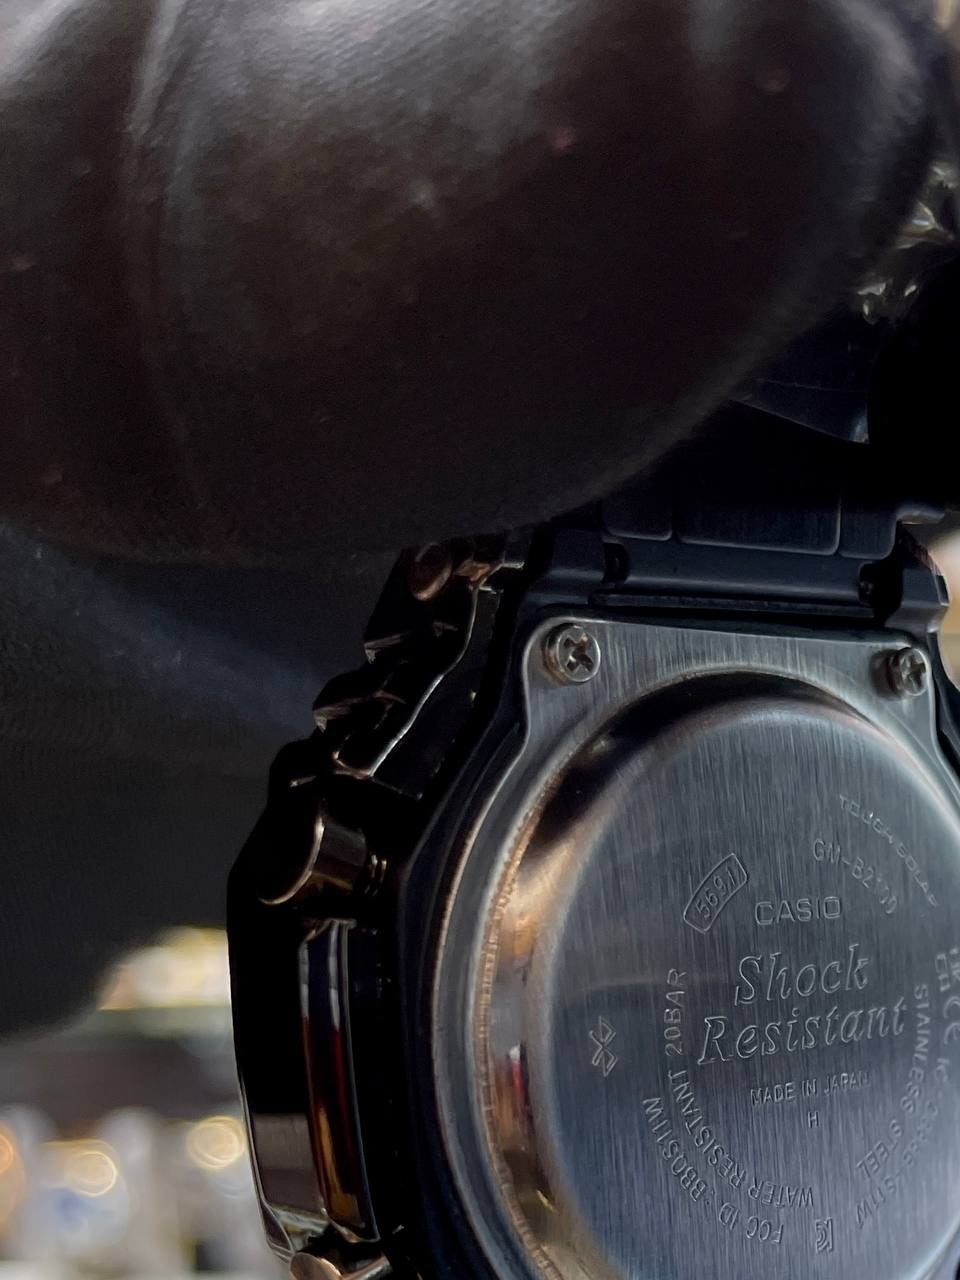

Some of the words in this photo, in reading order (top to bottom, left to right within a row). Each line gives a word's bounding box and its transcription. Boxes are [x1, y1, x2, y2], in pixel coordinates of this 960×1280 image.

[695, 865, 739, 919] 5691
[754, 895, 842, 926] CASIO
[734, 943, 869, 1006] Shock
[663, 968, 689, 1057] 20BAR
[697, 996, 906, 1065] Resistant
[900, 983, 931, 1115] STAINLESS
[750, 1083, 797, 1107] MADE
[801, 1078, 818, 1098] IN
[823, 1072, 871, 1098] JAPAN
[668, 1068, 748, 1190] RESISTANT
[807, 1111, 821, 1130] H
[748, 1176, 814, 1208] WATER
[746, 1214, 784, 1245] FCC
